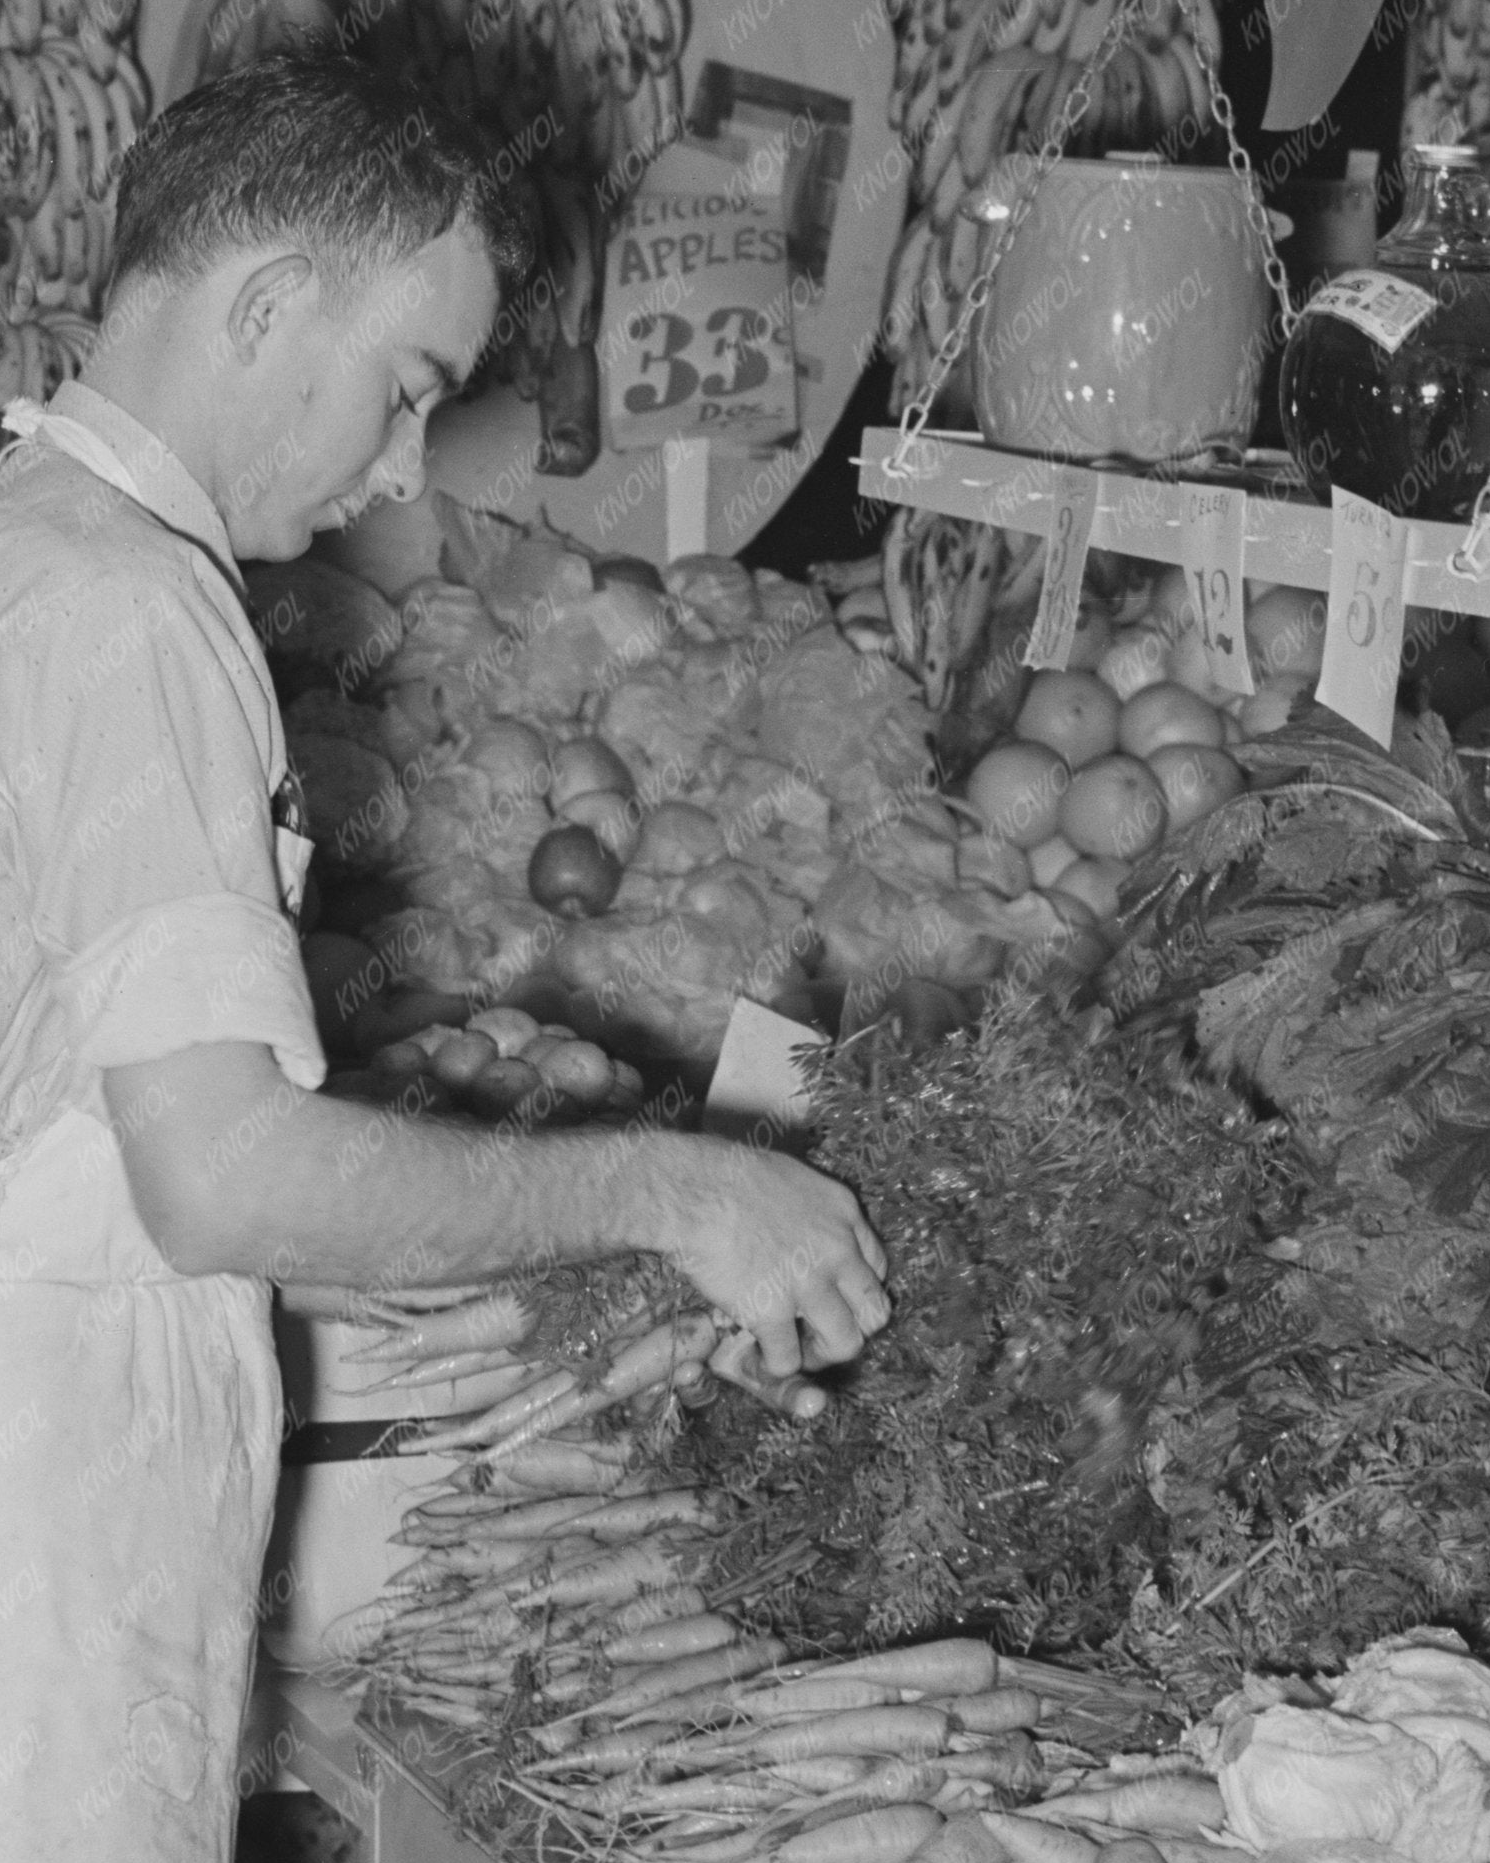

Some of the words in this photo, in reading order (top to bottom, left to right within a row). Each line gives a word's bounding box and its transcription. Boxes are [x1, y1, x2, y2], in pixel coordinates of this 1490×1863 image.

[618, 226, 786, 286] APPLES
[1189, 492, 1233, 523] CELERY
[1193, 567, 1235, 656] 12
